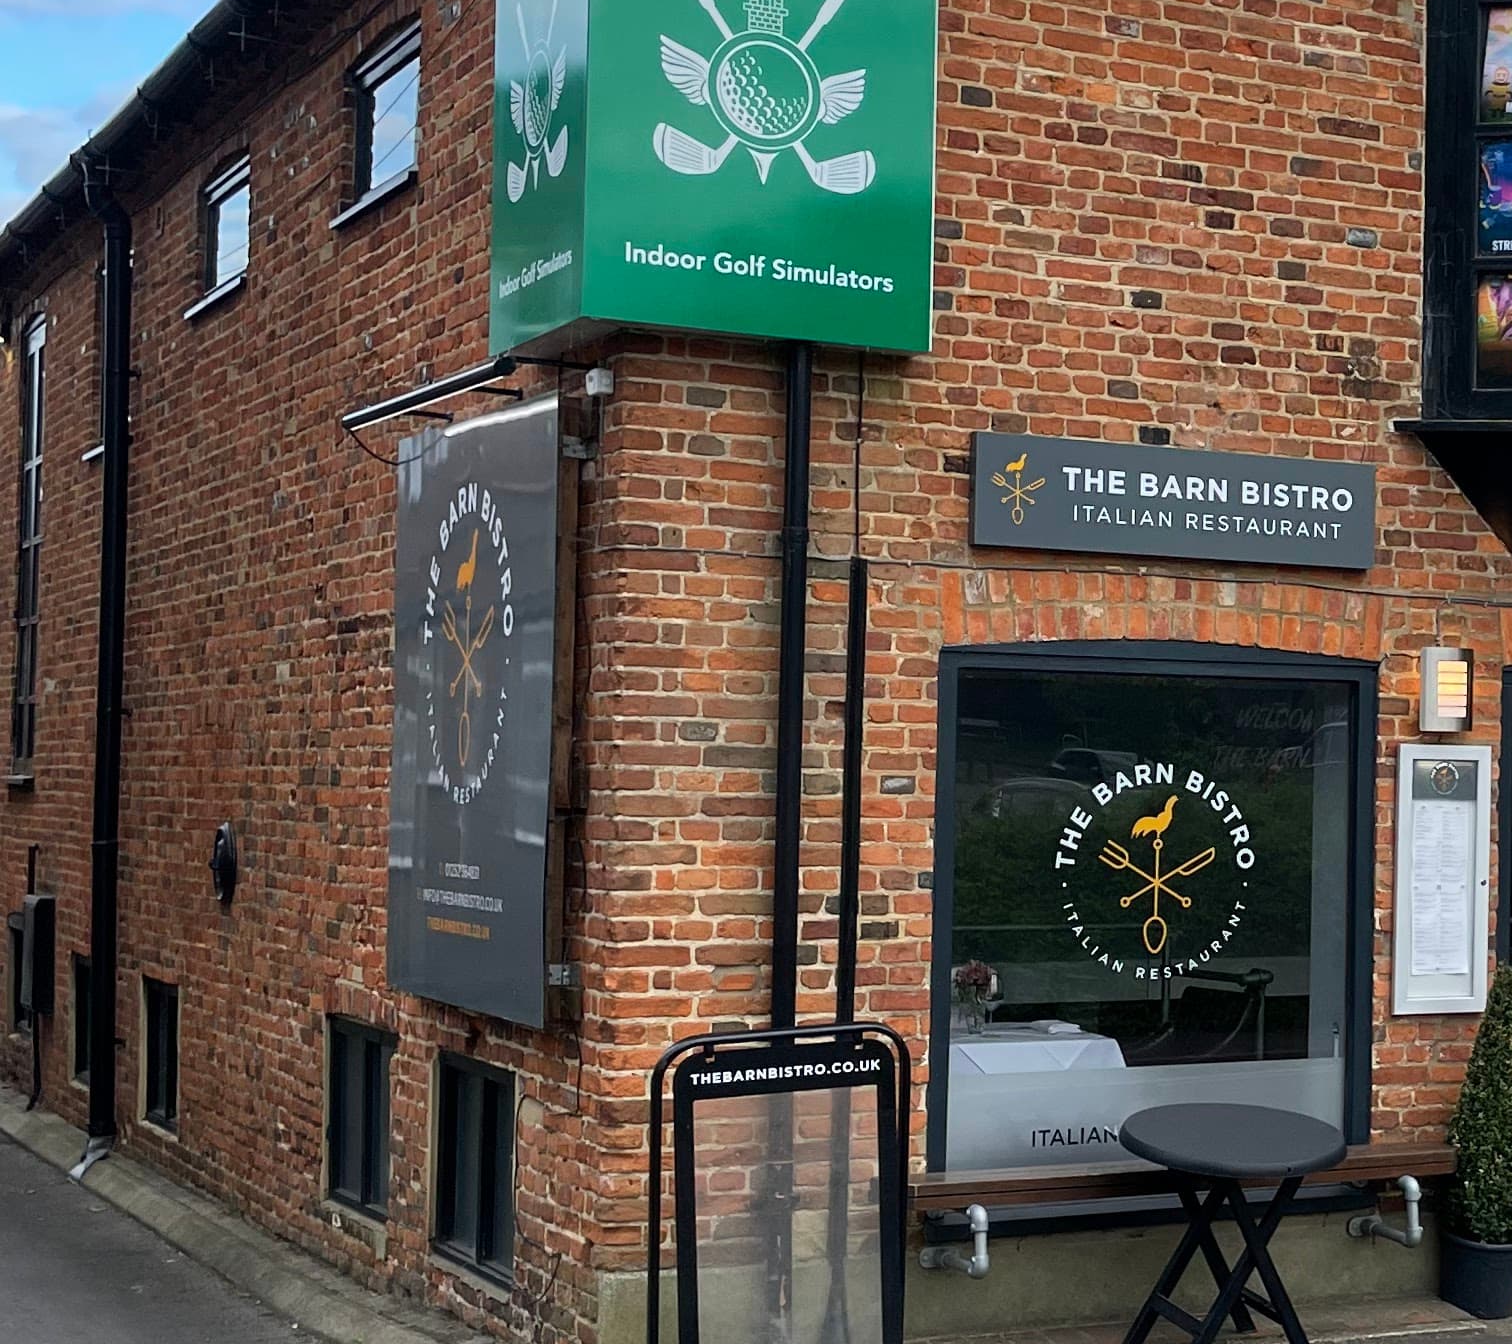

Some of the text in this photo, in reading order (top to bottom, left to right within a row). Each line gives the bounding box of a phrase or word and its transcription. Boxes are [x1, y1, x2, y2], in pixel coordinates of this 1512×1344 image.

[499, 250, 572, 299] Indoor Golf Simulators
[624, 241, 894, 293] Indoor Golf Simulators
[1062, 466, 1353, 512] THE BARN BISTRO
[1073, 504, 1342, 540] ITALIAN RESTAURANT
[423, 482, 514, 645] THE BARN BISTRO
[453, 686, 507, 805] RESTAURANT
[1055, 762, 1255, 870] THE BARN BISTRO
[1063, 901, 1246, 980] ITALIAN RESTAURANT
[690, 1058, 881, 1085] THEBARNBISTRO.CO.UK
[1031, 1126, 1118, 1148] ITALIAN
